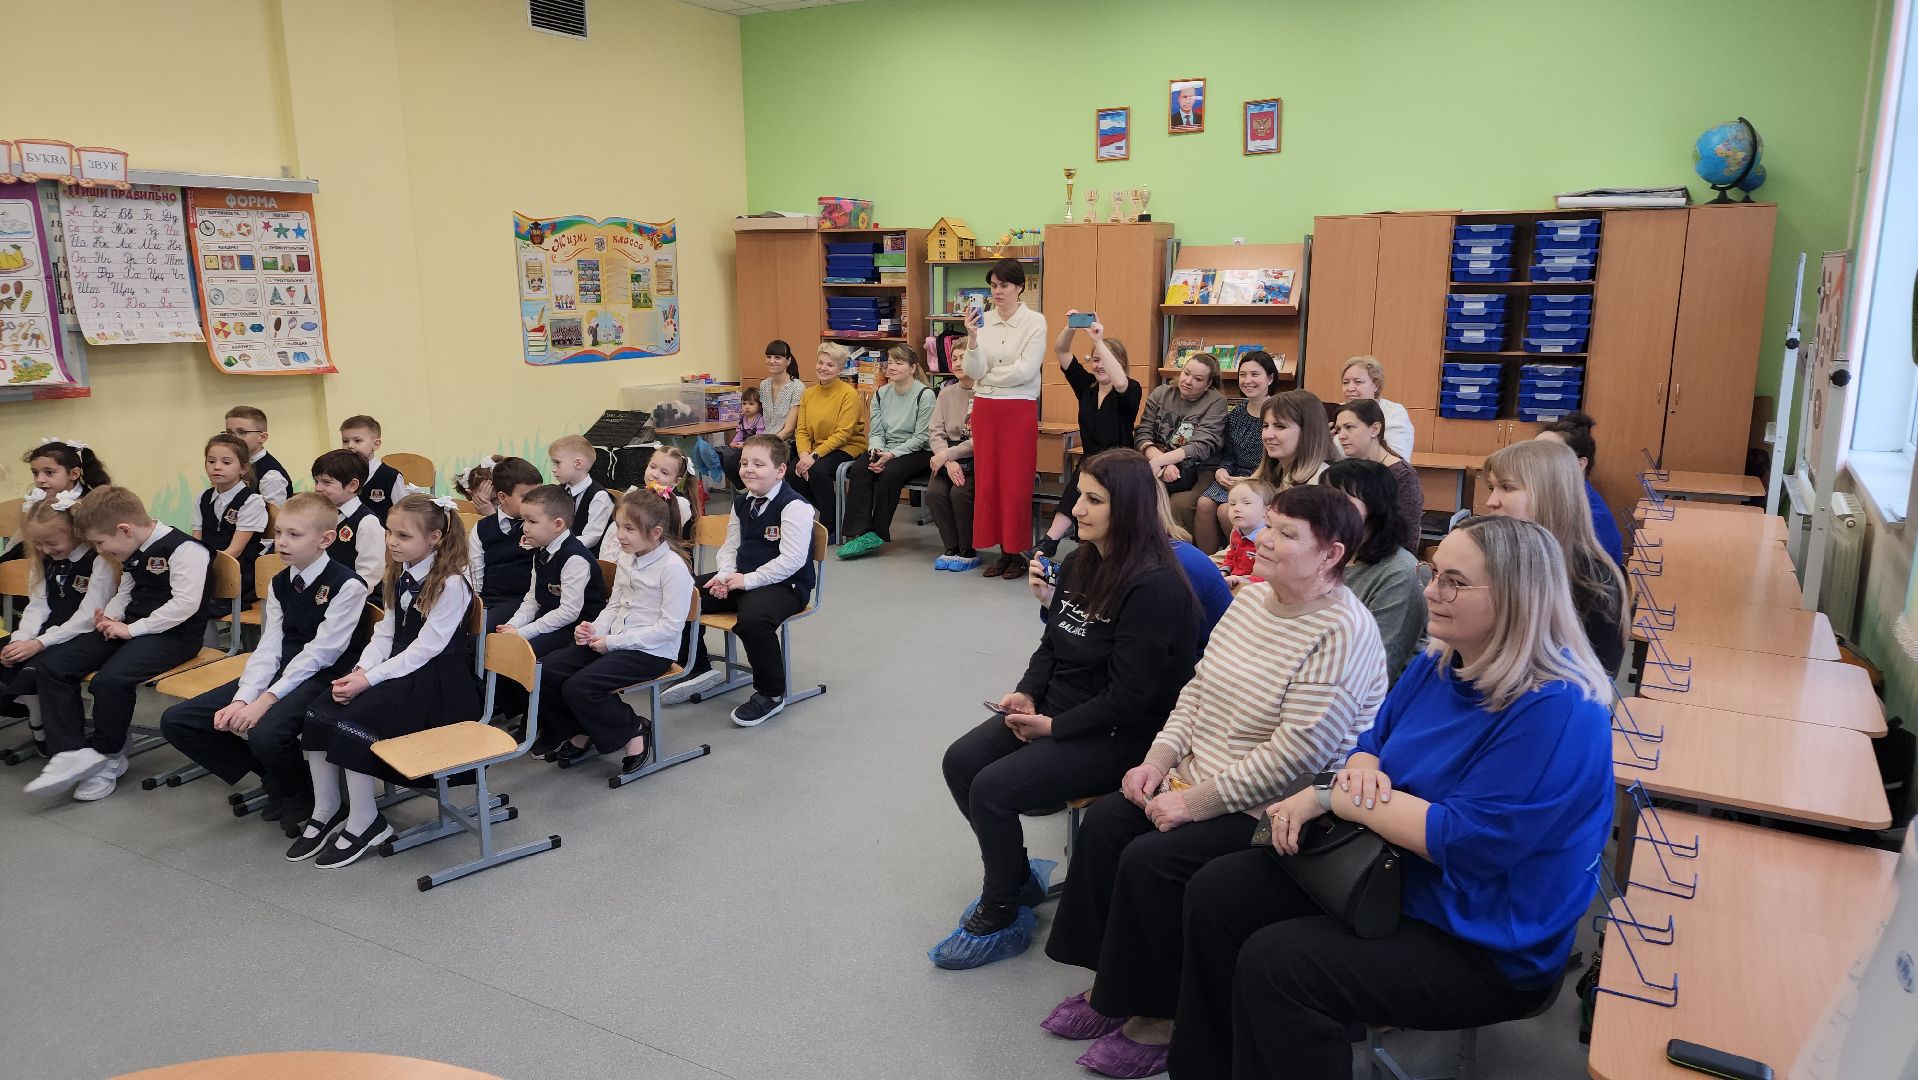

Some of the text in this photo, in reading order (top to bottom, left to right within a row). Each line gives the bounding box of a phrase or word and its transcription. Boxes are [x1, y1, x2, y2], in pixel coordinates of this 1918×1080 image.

[25, 152, 68, 165] БУКВА
[88, 160, 119, 171] ЗВУК
[111, 188, 177, 202] ПРАВИЛЬНО
[225, 193, 278, 209] ФОРМА
[552, 234, 645, 253] Жизнь класса
